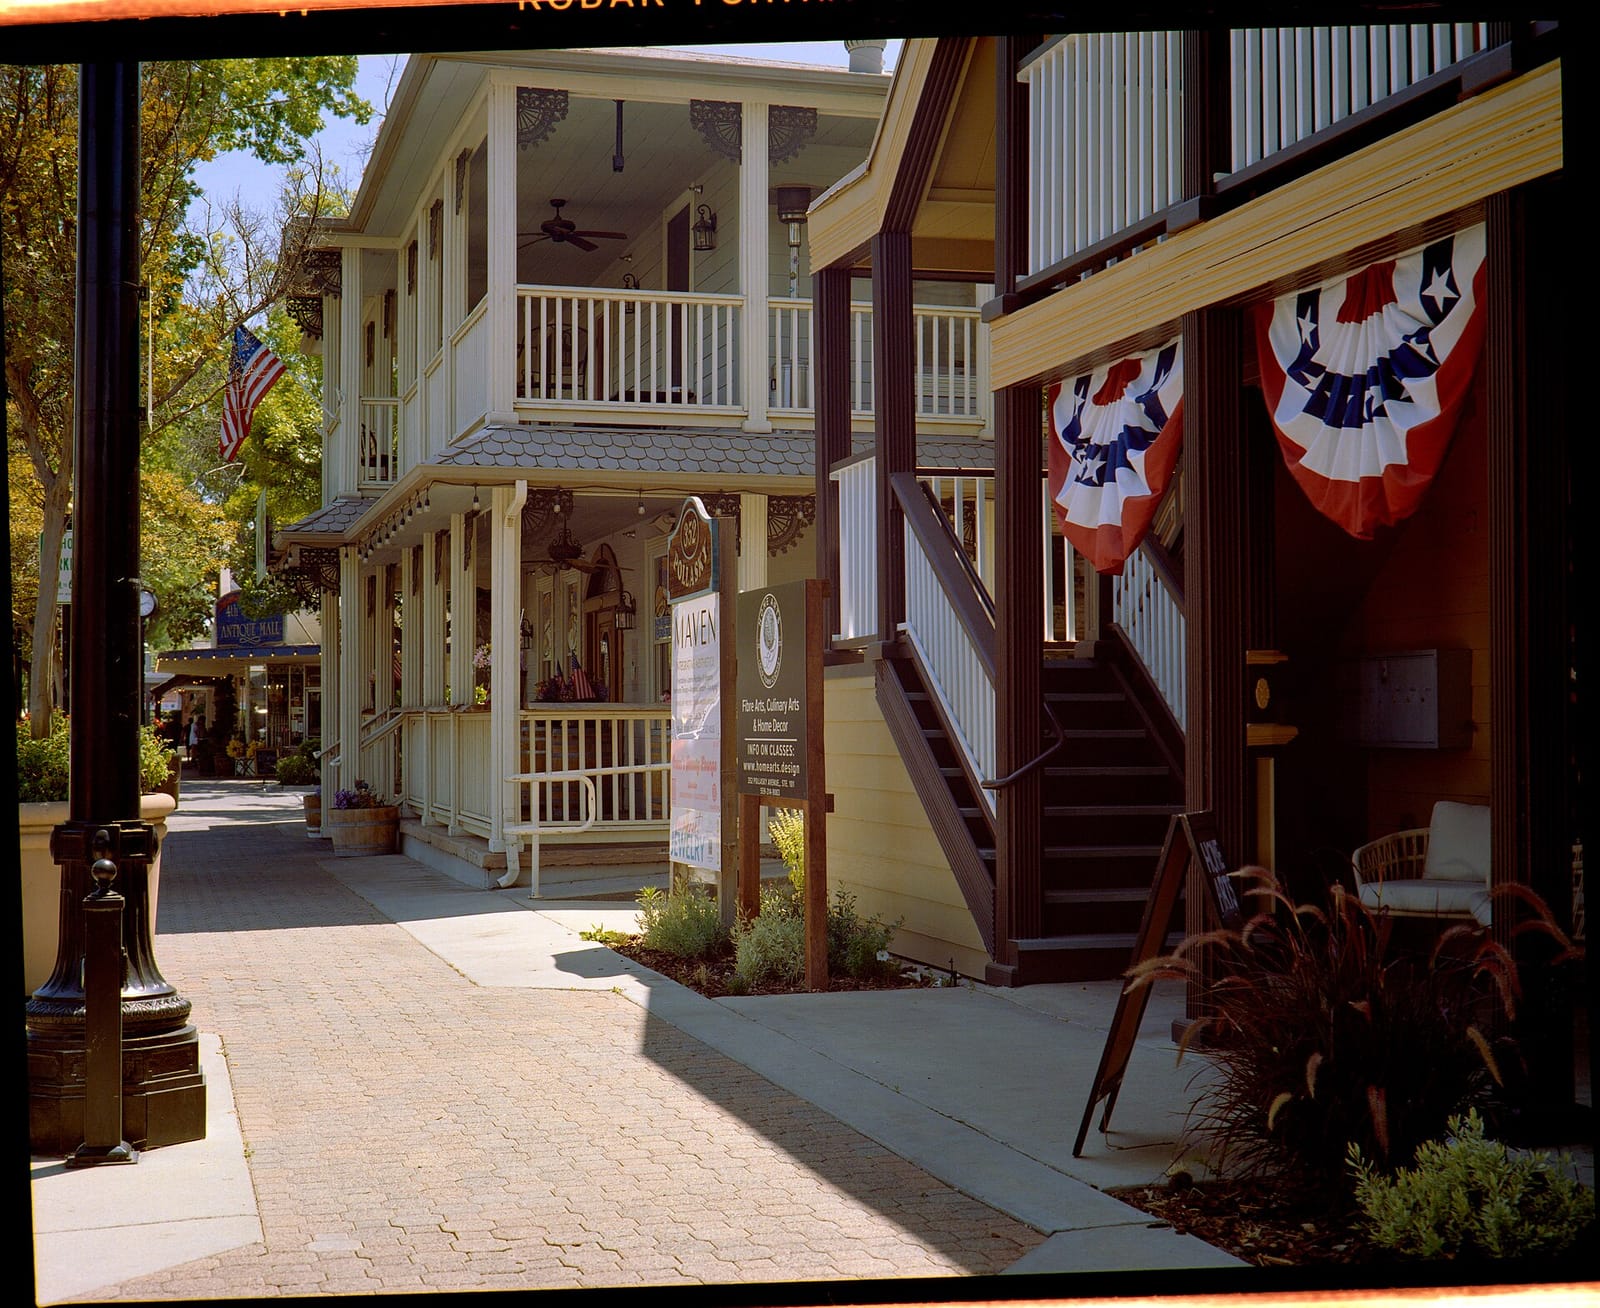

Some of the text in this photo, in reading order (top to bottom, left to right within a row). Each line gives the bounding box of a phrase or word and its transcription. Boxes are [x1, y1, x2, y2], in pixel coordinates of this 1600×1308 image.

[683, 518, 697, 548] 352
[673, 537, 707, 588] POLLASKY
[221, 621, 280, 639] ANTIQUE MALL
[674, 608, 717, 649] MAVEN
[742, 697, 800, 715] Fibre Arts, Culinary Arts
[752, 718, 789, 733] & Home Decor
[747, 744, 795, 757] INFO ON CLASSES:
[743, 761, 800, 777] www.homearts.design
[671, 831, 704, 863] JEWELRY
